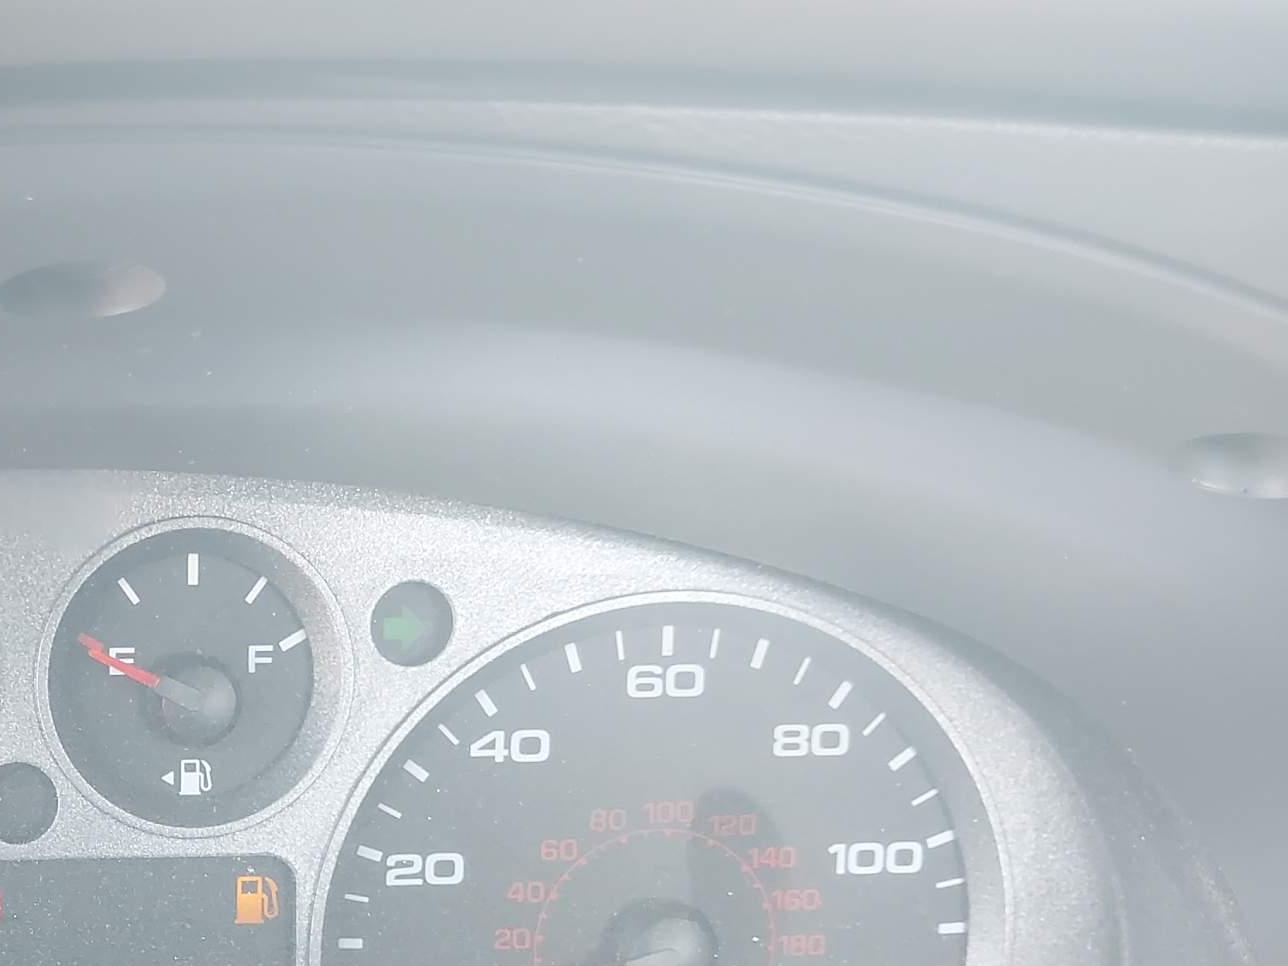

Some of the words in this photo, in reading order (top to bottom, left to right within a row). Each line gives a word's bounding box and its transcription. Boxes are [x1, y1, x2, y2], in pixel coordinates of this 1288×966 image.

[108, 647, 136, 676] E
[248, 644, 274, 673] F
[626, 663, 705, 698] 60
[470, 729, 551, 763] 40
[773, 723, 850, 757] 80
[590, 808, 627, 832] 80
[643, 800, 694, 824] 100
[712, 814, 757, 836] 120
[541, 839, 578, 862] 60
[751, 847, 797, 869] 140
[827, 841, 923, 875] 100
[386, 852, 465, 886] 20
[506, 881, 545, 903] 40
[772, 889, 821, 911] 160
[495, 928, 532, 950] 20
[778, 936, 826, 956] 180
